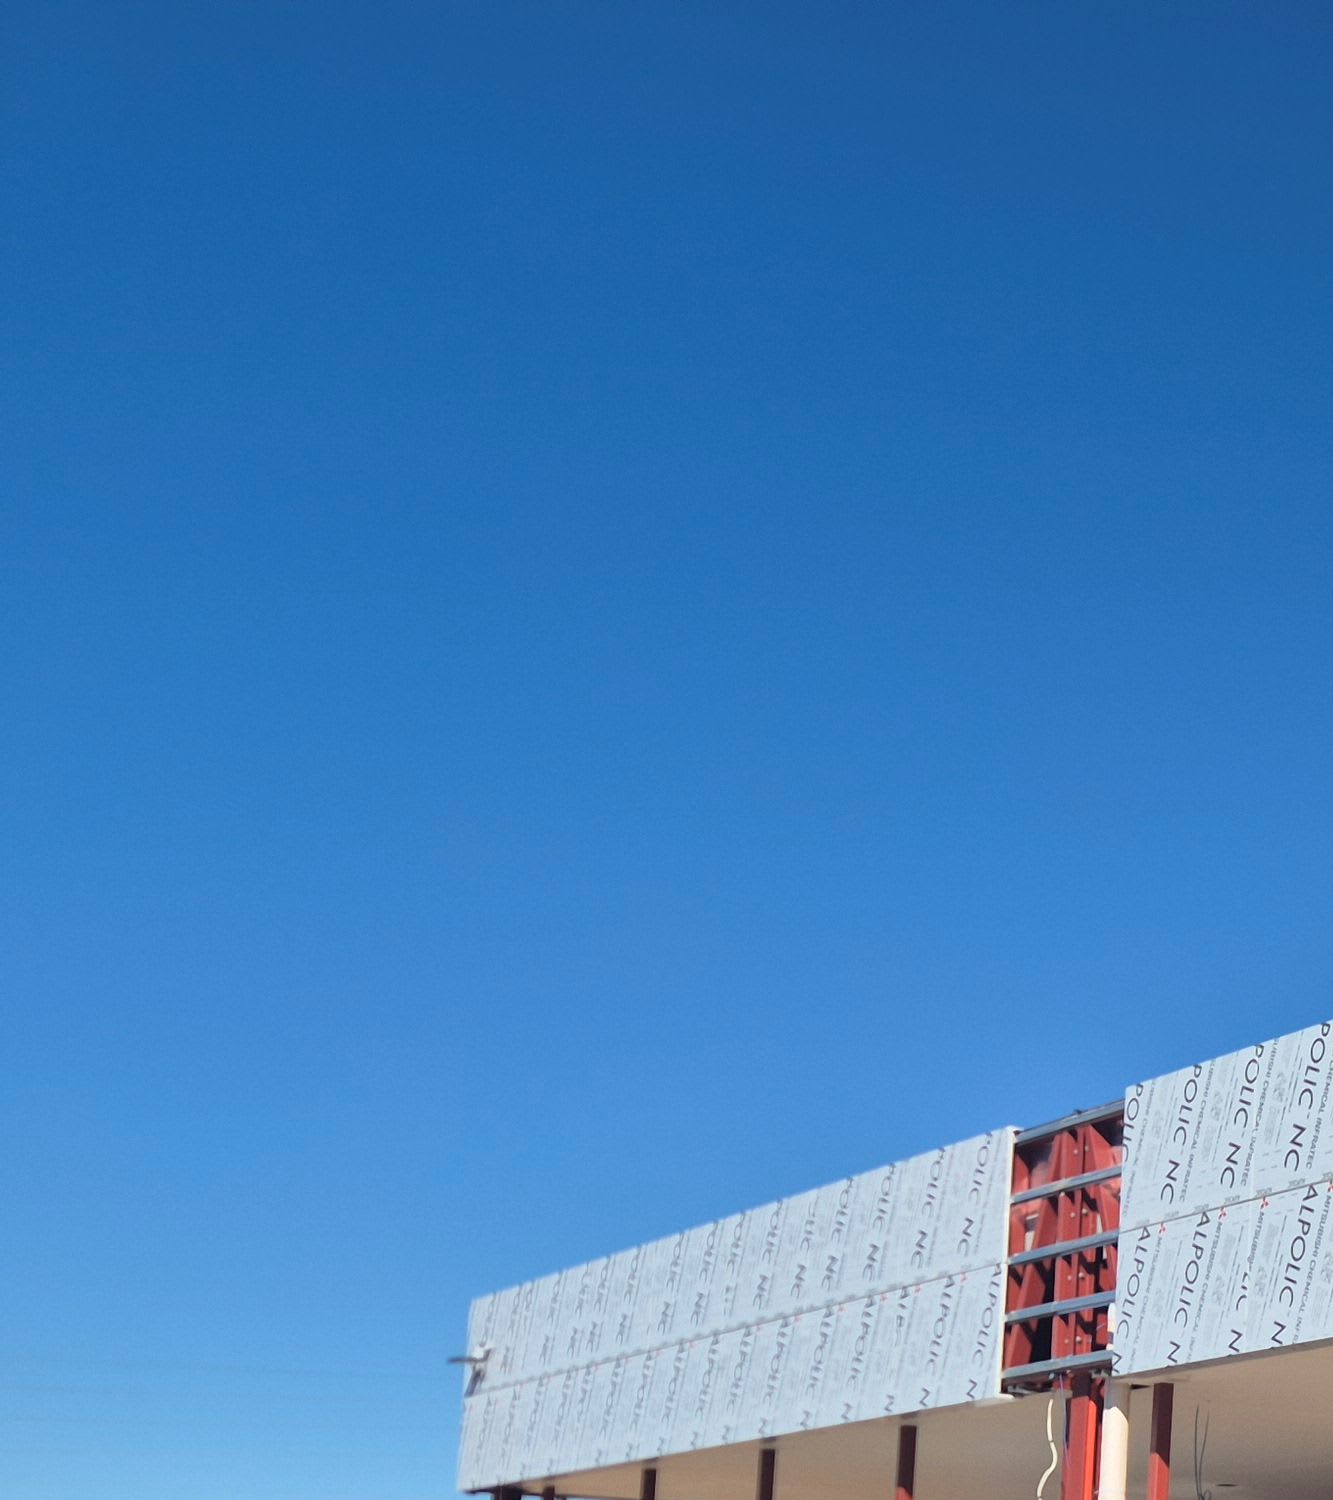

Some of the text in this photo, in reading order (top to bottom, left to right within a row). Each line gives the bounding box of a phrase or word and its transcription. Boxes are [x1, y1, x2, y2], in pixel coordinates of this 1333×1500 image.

[1161, 1064, 1202, 1204] POLIC NC
[1221, 1045, 1264, 1188] POLIC NC
[1284, 1023, 1330, 1171] POLIC NC
[863, 1244, 880, 1281] NC
[910, 1230, 928, 1269] NC
[958, 1217, 974, 1256] NC
[1117, 1226, 1150, 1338] ALPOLIC
[1175, 1212, 1210, 1327] ALPOLIC
[1279, 1184, 1318, 1307] ALPOLIC
